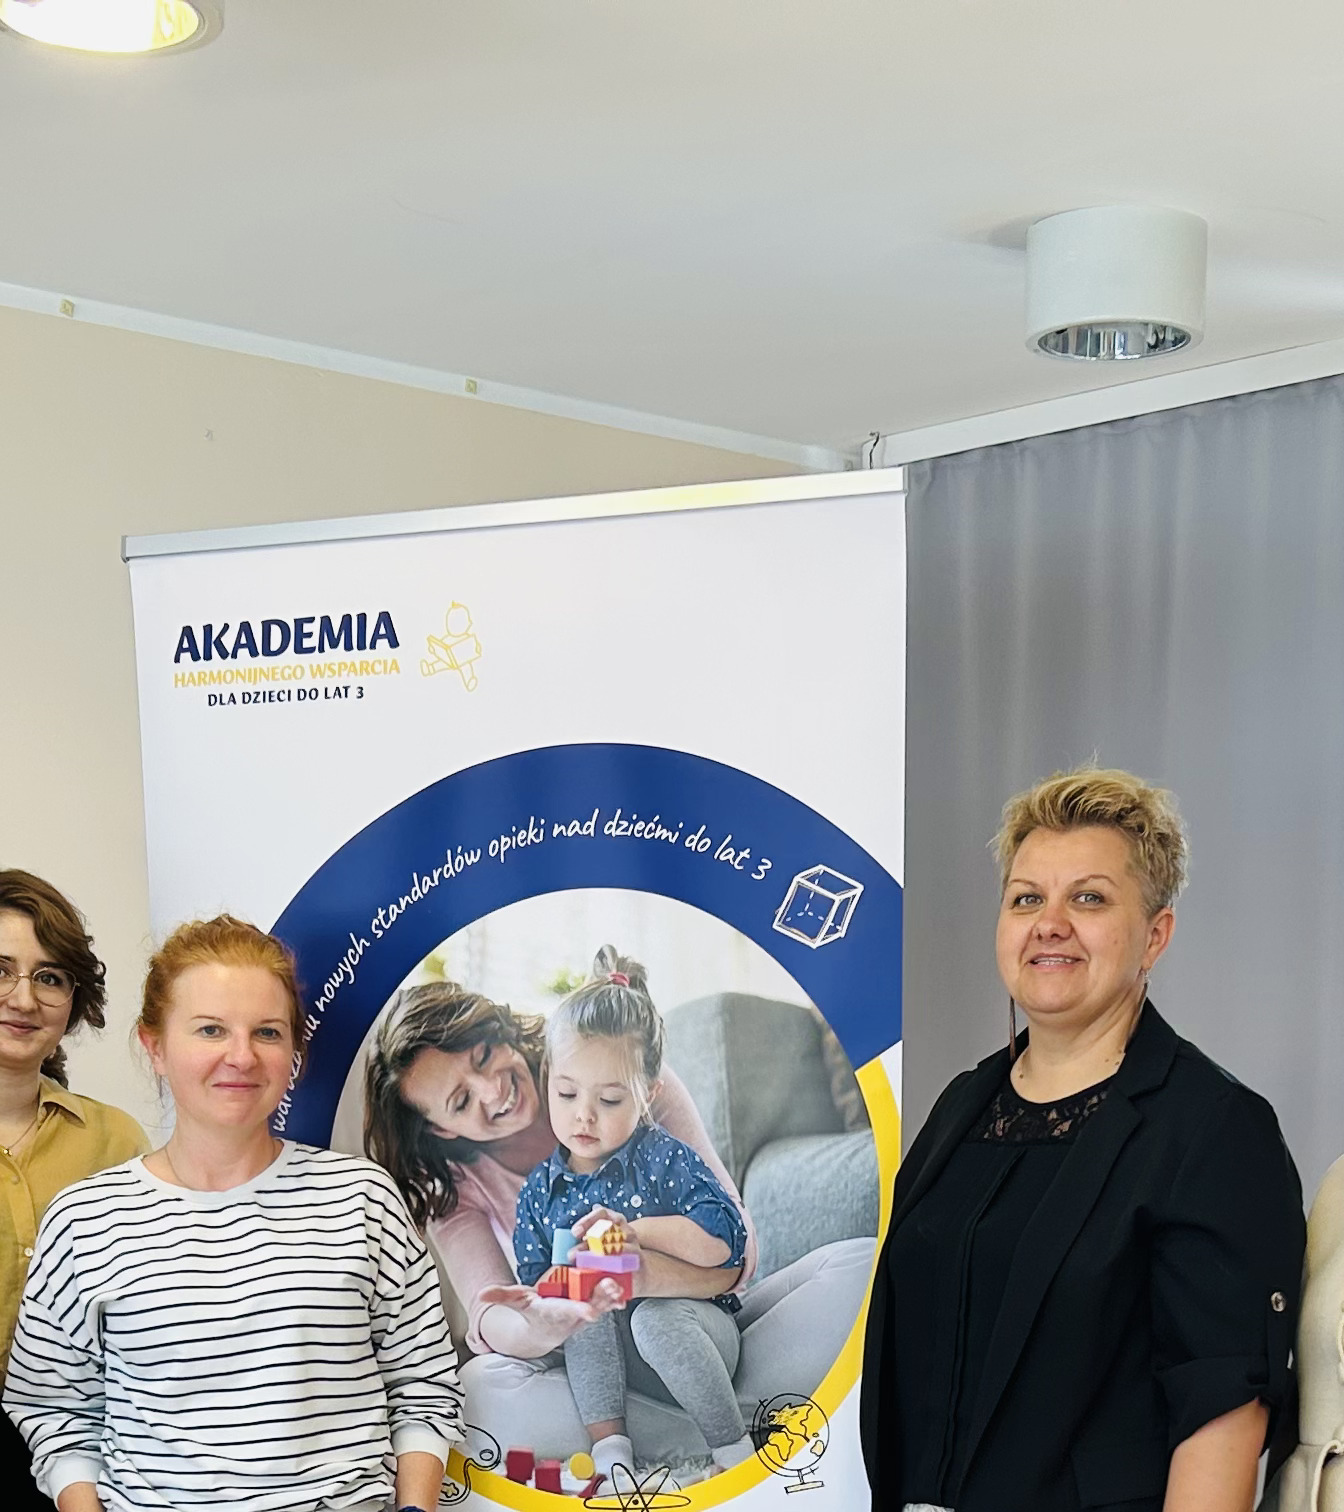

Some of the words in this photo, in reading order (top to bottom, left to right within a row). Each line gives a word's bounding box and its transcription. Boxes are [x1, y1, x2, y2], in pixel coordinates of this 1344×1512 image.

[174, 611, 400, 663] AKADEMIA
[174, 664, 306, 688] HARMONIJNEGO
[309, 658, 401, 680] WSPARCIA
[207, 693, 237, 707] DLA
[241, 689, 292, 705] DZIECI
[297, 687, 319, 702] DO
[324, 685, 352, 700] LAT
[355, 686, 365, 700] 3
[314, 932, 371, 1012] nowych
[371, 847, 481, 939] standardów
[488, 815, 545, 863] opieki
[552, 808, 599, 837] nad
[603, 808, 684, 844] dziećmi
[684, 825, 712, 853] do
[714, 834, 751, 870] lat
[751, 857, 773, 881] 3
